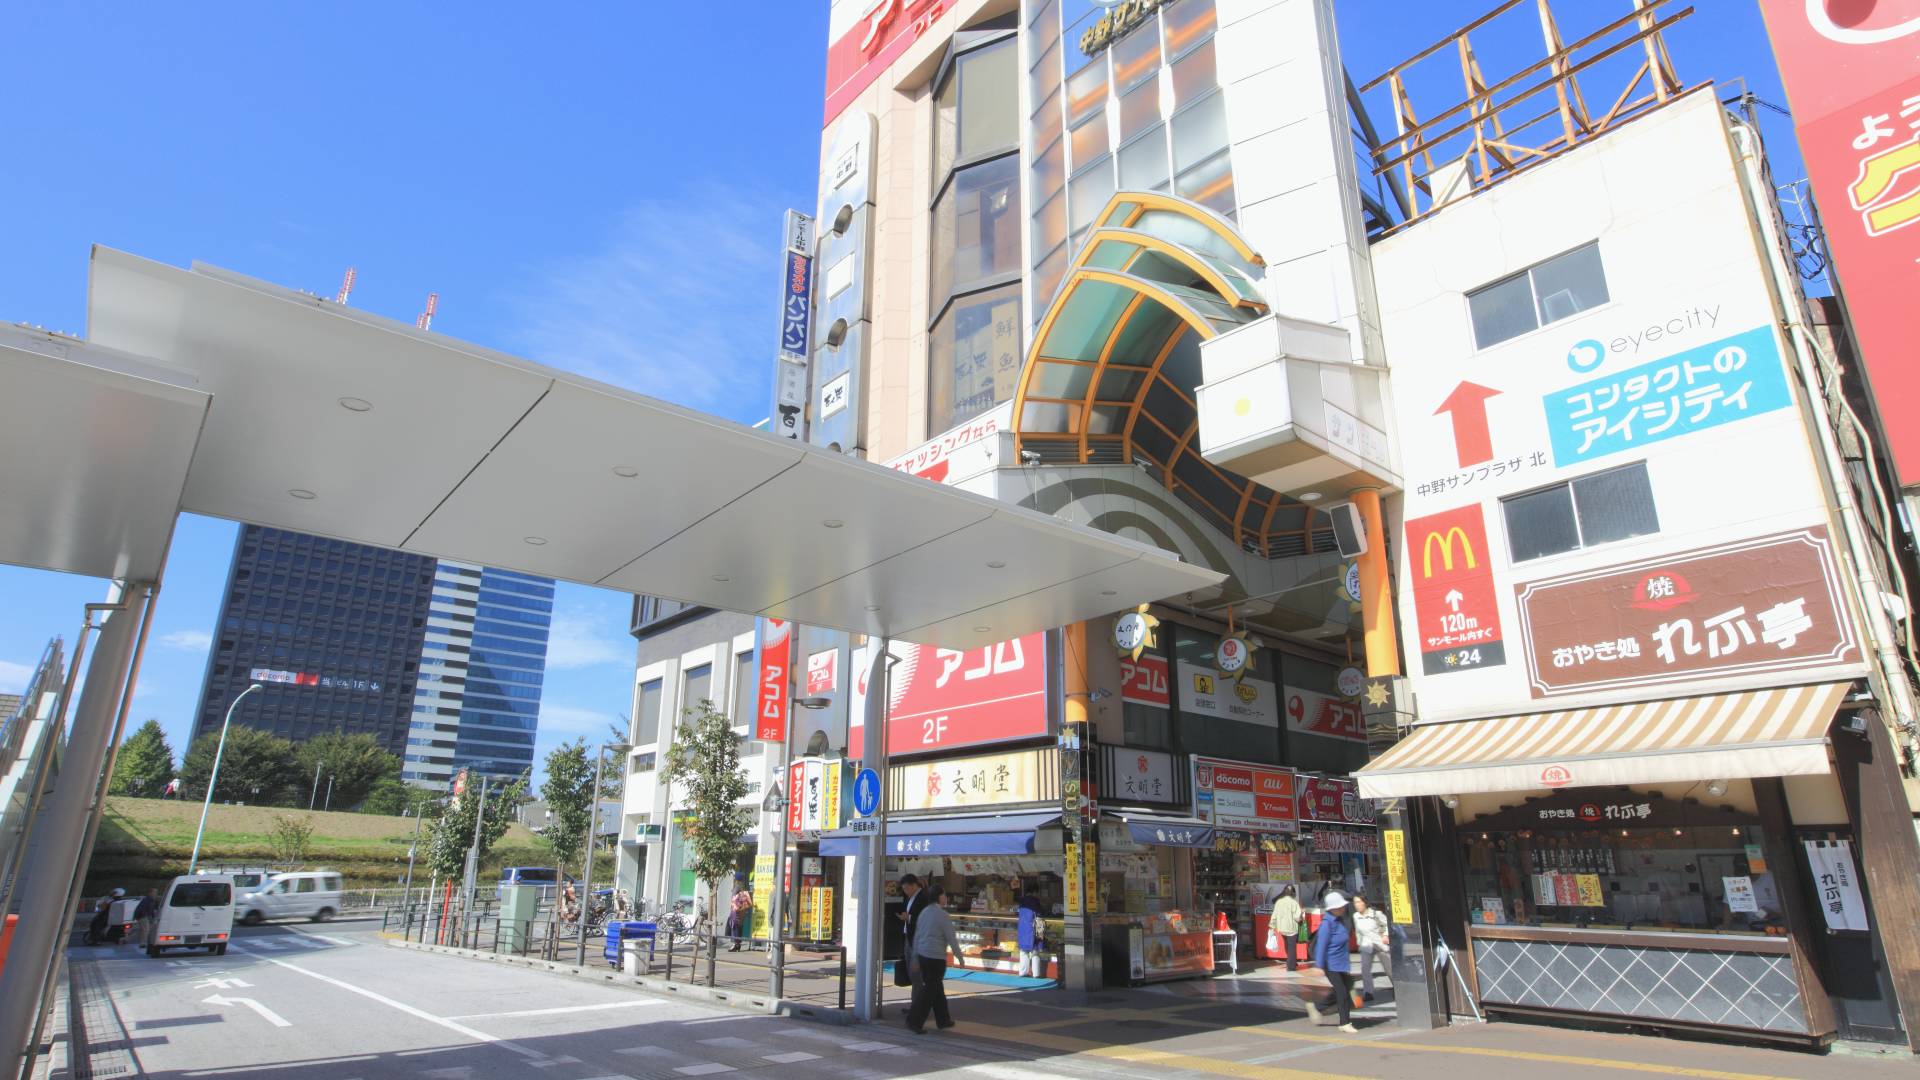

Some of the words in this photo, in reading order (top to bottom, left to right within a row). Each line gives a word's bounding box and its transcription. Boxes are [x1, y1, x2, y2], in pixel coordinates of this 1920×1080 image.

[1610, 304, 1721, 354] eyecity
[1566, 345, 1748, 420] コンタクトの
[1571, 380, 1753, 455] アイシティ
[1416, 456, 1523, 497] 中野サンプラザ
[1528, 450, 1547, 468] 北
[1647, 575, 1676, 600] 焼
[1427, 627, 1494, 647] サンモール内すぐ
[1440, 612, 1478, 634] 120m
[1459, 648, 1482, 666] 24
[1551, 637, 1641, 669] おやき処
[811, 669, 830, 682] アコム
[1120, 662, 1168, 694] アコム
[763, 665, 782, 719] アコム
[762, 728, 778, 740] 2F
[922, 715, 949, 744] 2F
[952, 763, 1011, 795] 文明堂
[1125, 775, 1162, 796] 文明堂
[1216, 773, 1250, 786] docomo
[1263, 778, 1284, 790] au
[792, 780, 803, 828] アイフル
[1539, 809, 1575, 819] おやき処
[853, 821, 880, 832] 自転車を除く
[824, 889, 832, 928] カラオケ
